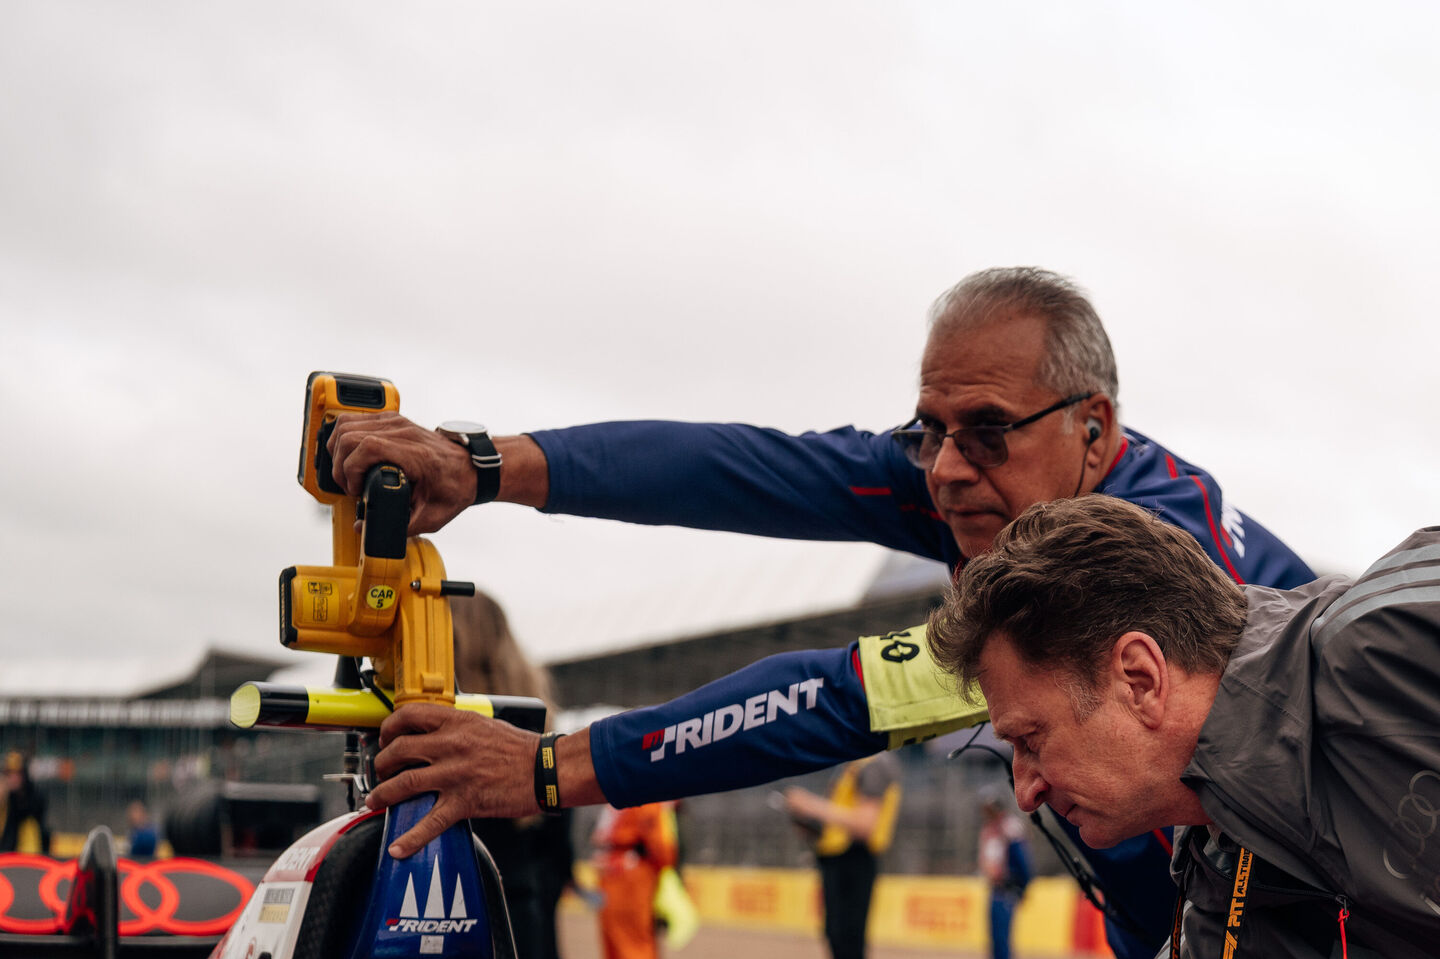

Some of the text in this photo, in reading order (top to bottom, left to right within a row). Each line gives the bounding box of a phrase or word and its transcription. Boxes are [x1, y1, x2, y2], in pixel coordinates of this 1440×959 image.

[370, 588, 394, 599] CAR
[376, 599, 384, 608] 5
[642, 677, 824, 762] TRIDENT
[1227, 898, 1245, 927] PIT
[385, 918, 478, 934] TRIDENT
